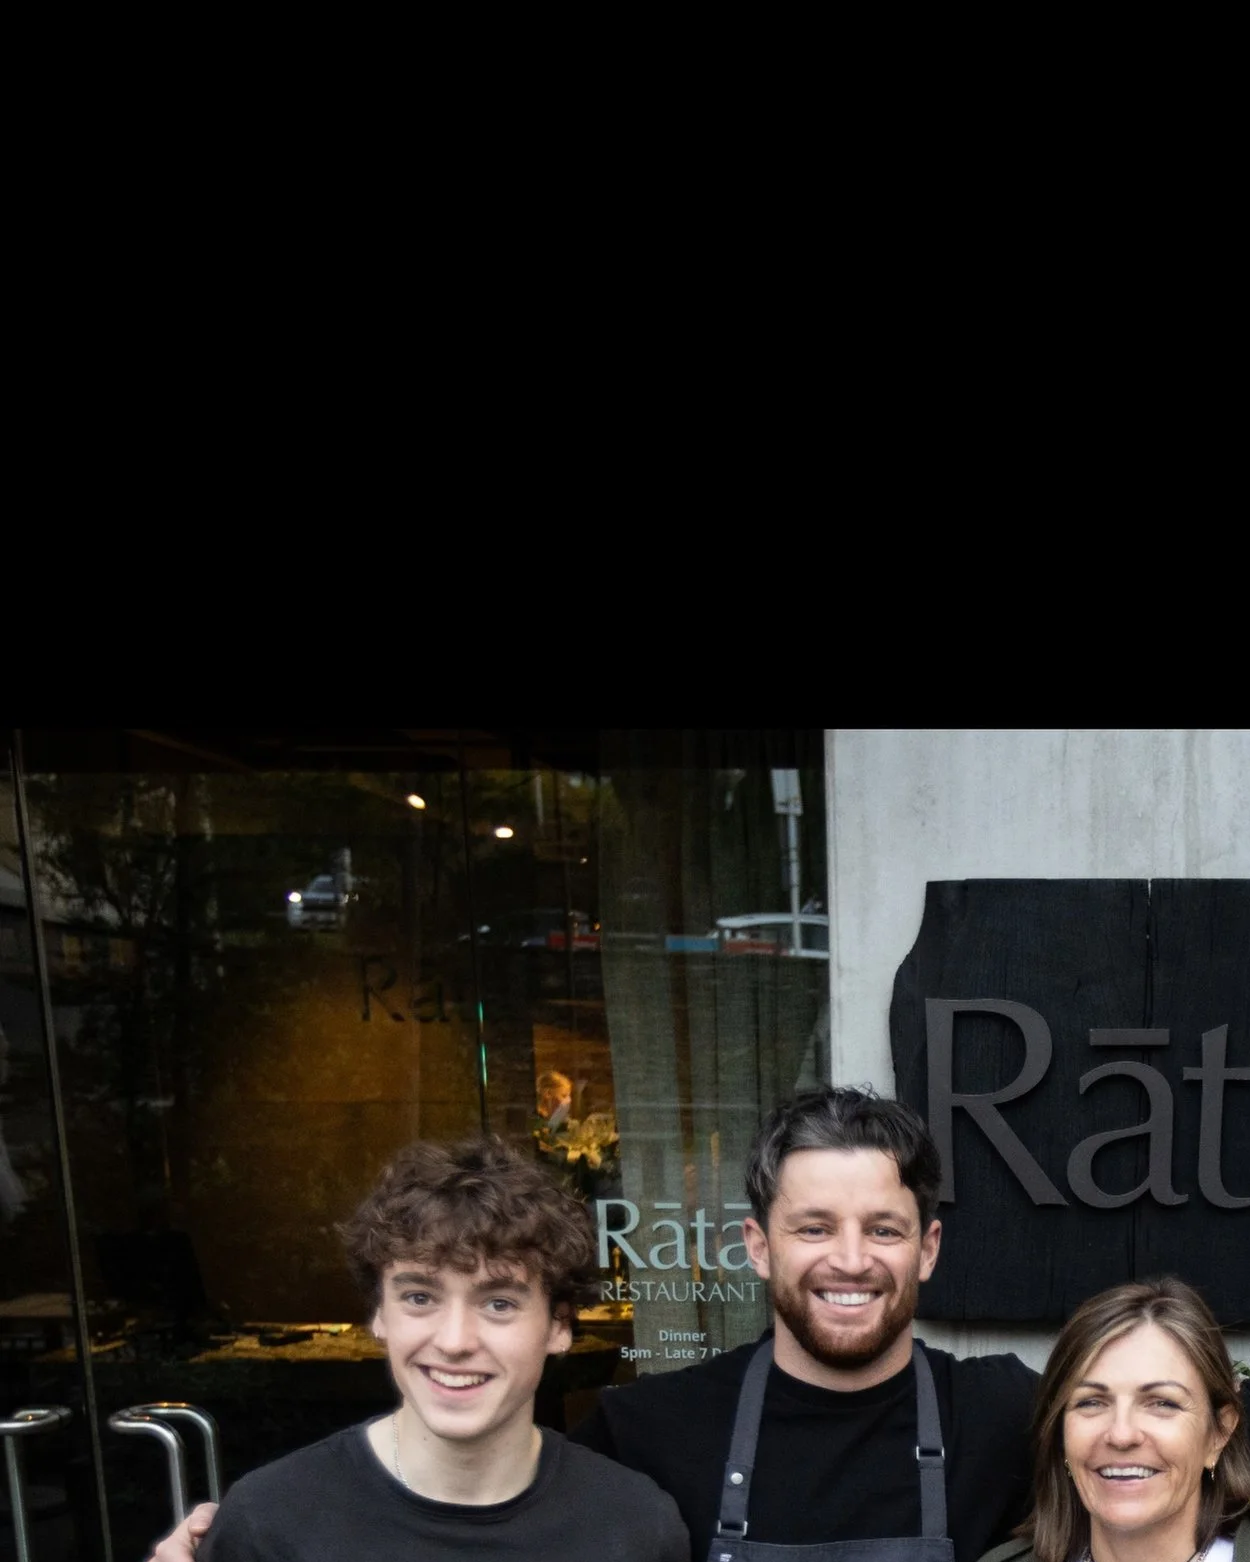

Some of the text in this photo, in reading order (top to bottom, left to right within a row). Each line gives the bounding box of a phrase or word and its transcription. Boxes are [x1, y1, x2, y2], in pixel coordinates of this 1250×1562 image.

[600, 1281, 761, 1302] RESTAURANT
[658, 1330, 707, 1342] Dinner
[620, 1346, 652, 1361] 5pm
[665, 1347, 695, 1359] Late
[699, 1347, 708, 1359] 7
